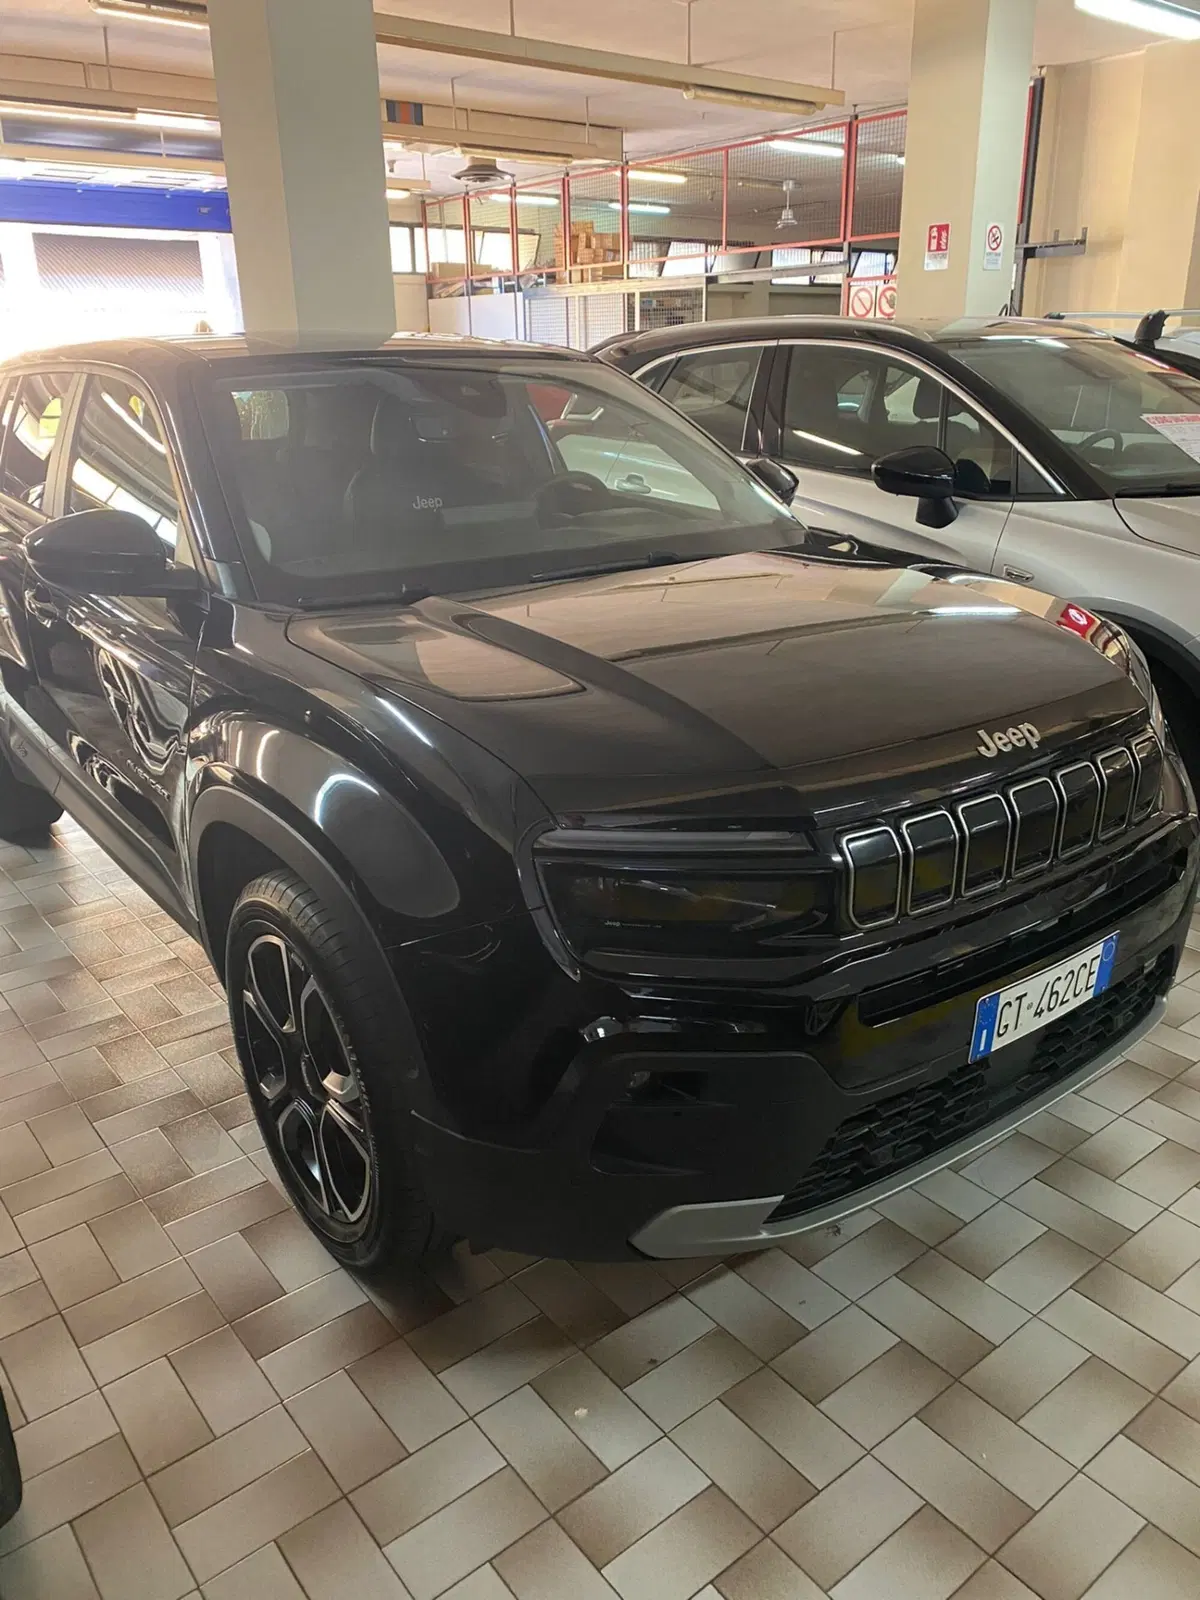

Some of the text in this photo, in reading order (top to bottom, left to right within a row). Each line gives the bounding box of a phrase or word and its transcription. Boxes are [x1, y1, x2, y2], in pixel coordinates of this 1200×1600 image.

[412, 495, 443, 512] Jeep
[977, 722, 1041, 757] Jeep
[996, 954, 1100, 1038] GT 462CE
[979, 1029, 988, 1051] I
